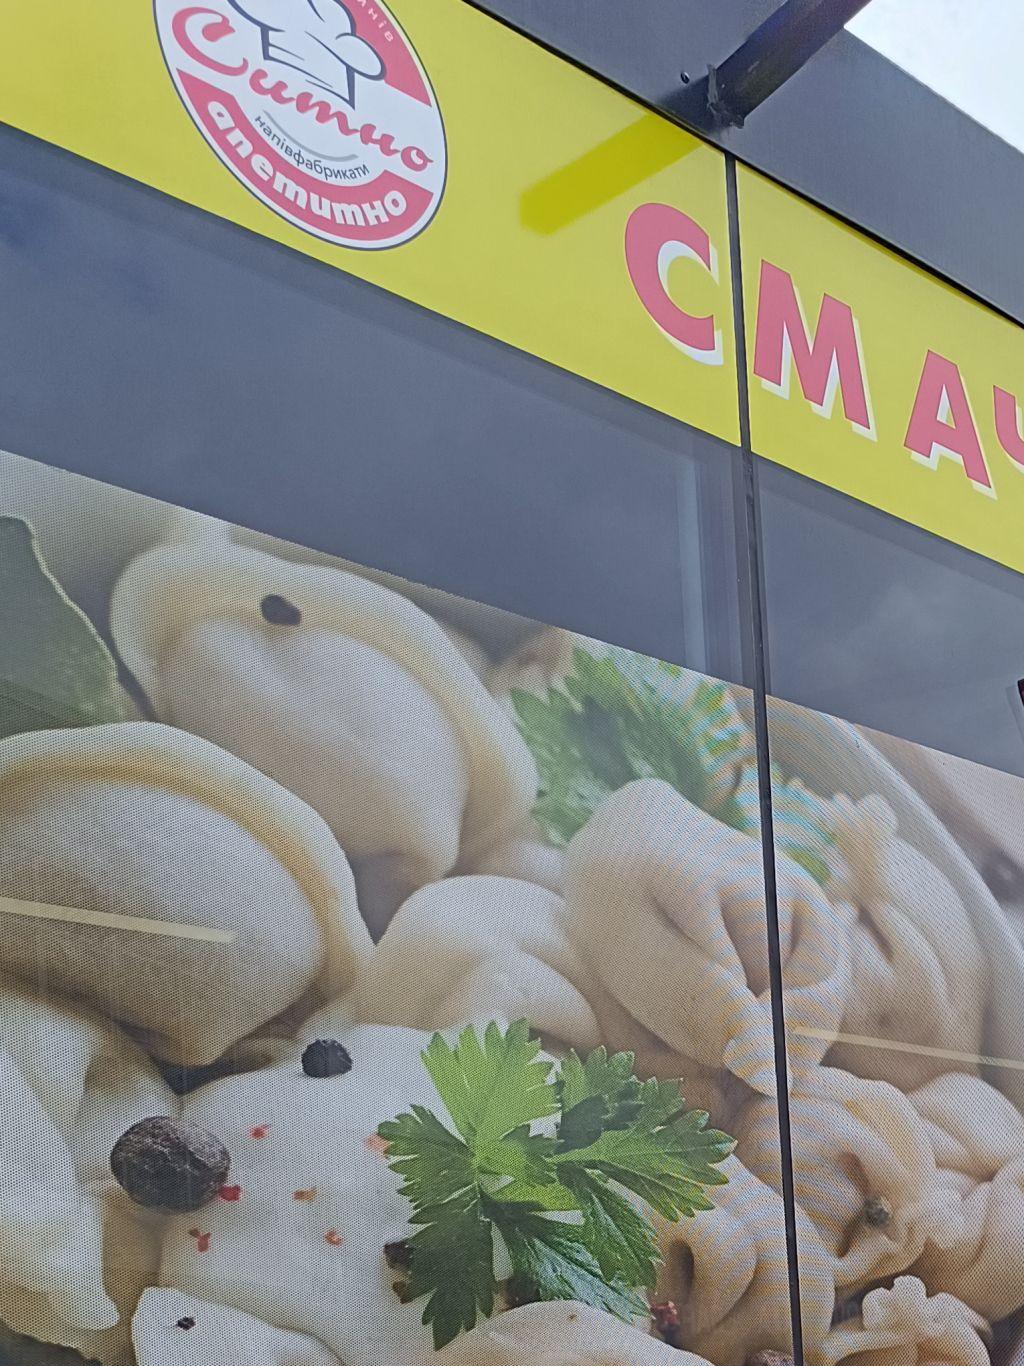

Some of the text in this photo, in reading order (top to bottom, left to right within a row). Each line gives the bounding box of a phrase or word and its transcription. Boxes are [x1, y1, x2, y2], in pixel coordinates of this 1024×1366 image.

[171, 6, 434, 173] Ситно
[254, 114, 371, 182] напівфабрикати
[206, 100, 408, 227] апетитно
